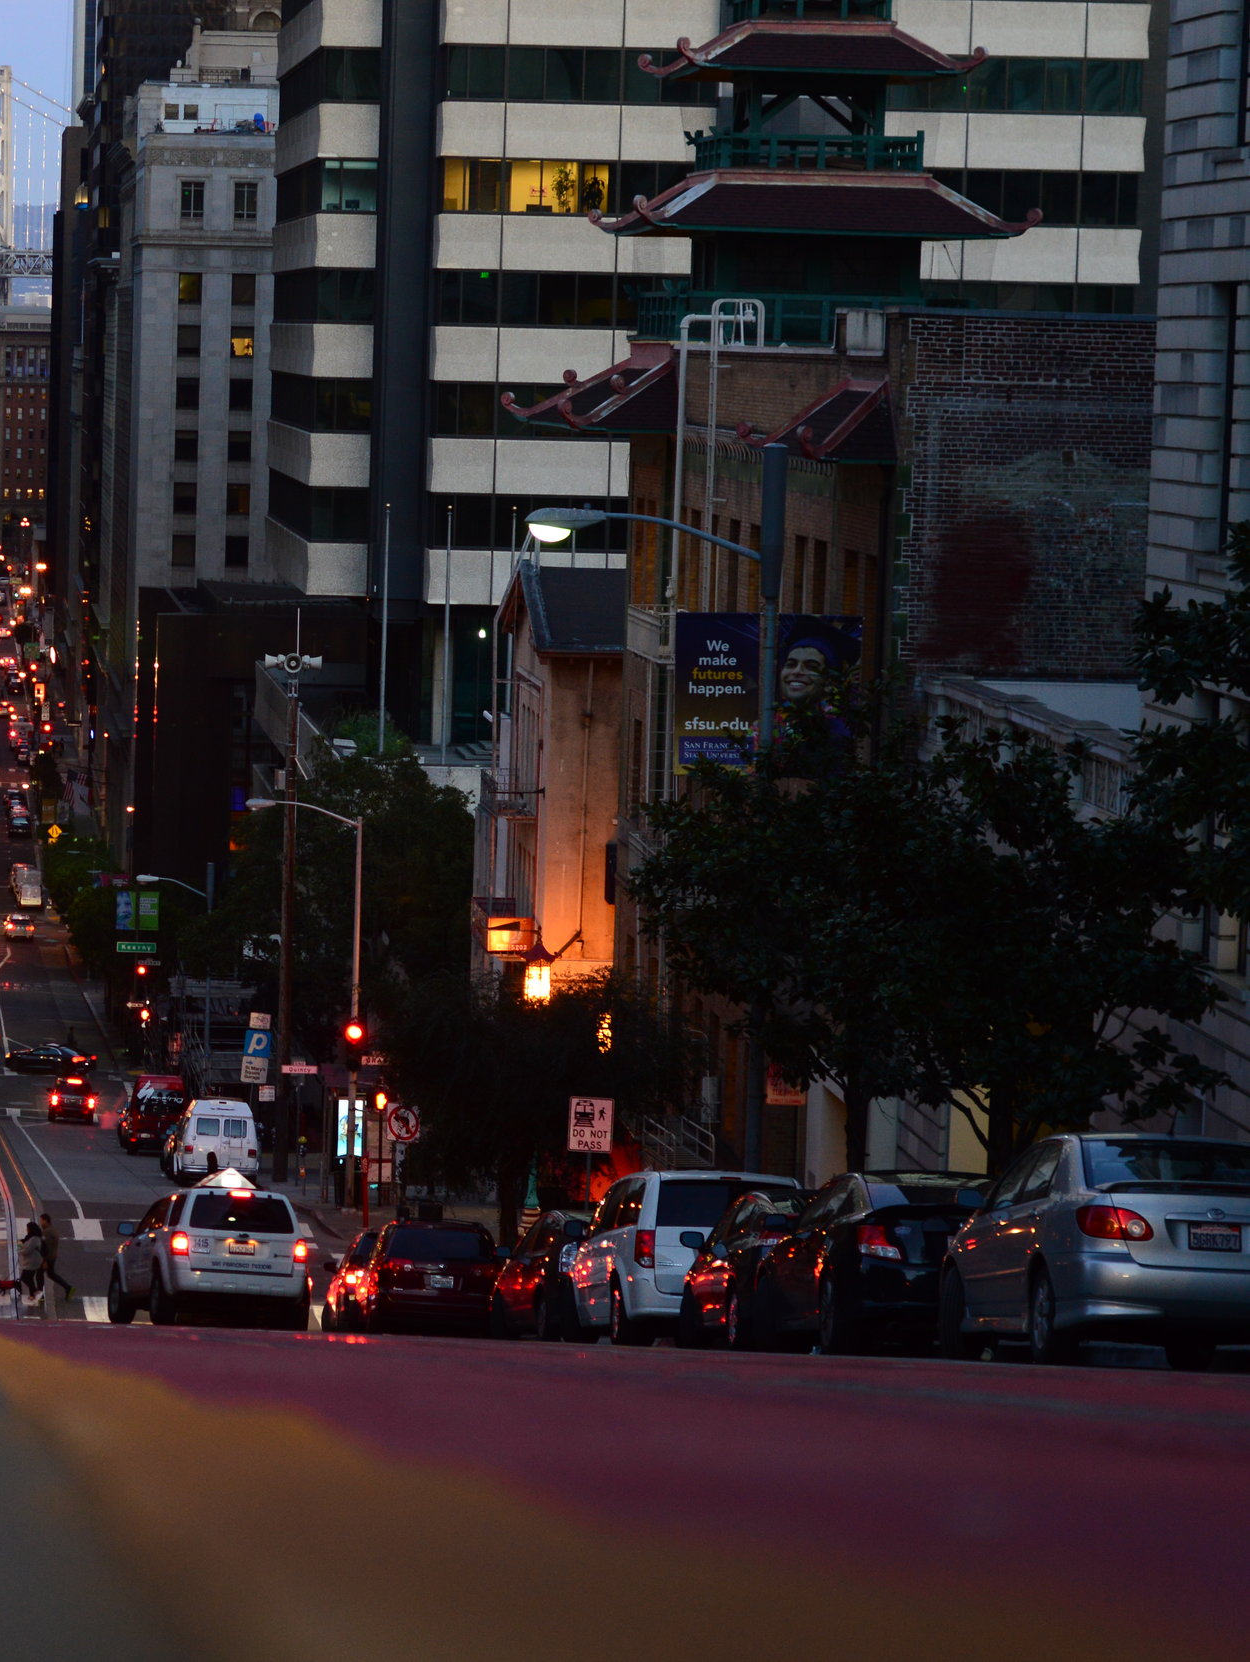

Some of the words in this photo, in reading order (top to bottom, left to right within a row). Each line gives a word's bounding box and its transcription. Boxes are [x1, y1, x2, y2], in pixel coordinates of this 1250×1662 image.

[706, 640, 730, 652] We
[698, 653, 738, 666] make
[692, 667, 743, 680] futures
[688, 682, 746, 697] happen.
[684, 716, 749, 731] sfsu.edu
[248, 1033, 268, 1054] P
[573, 1129, 585, 1138] DO
[590, 1130, 608, 1139] NOT
[578, 1140, 602, 1149] PASS
